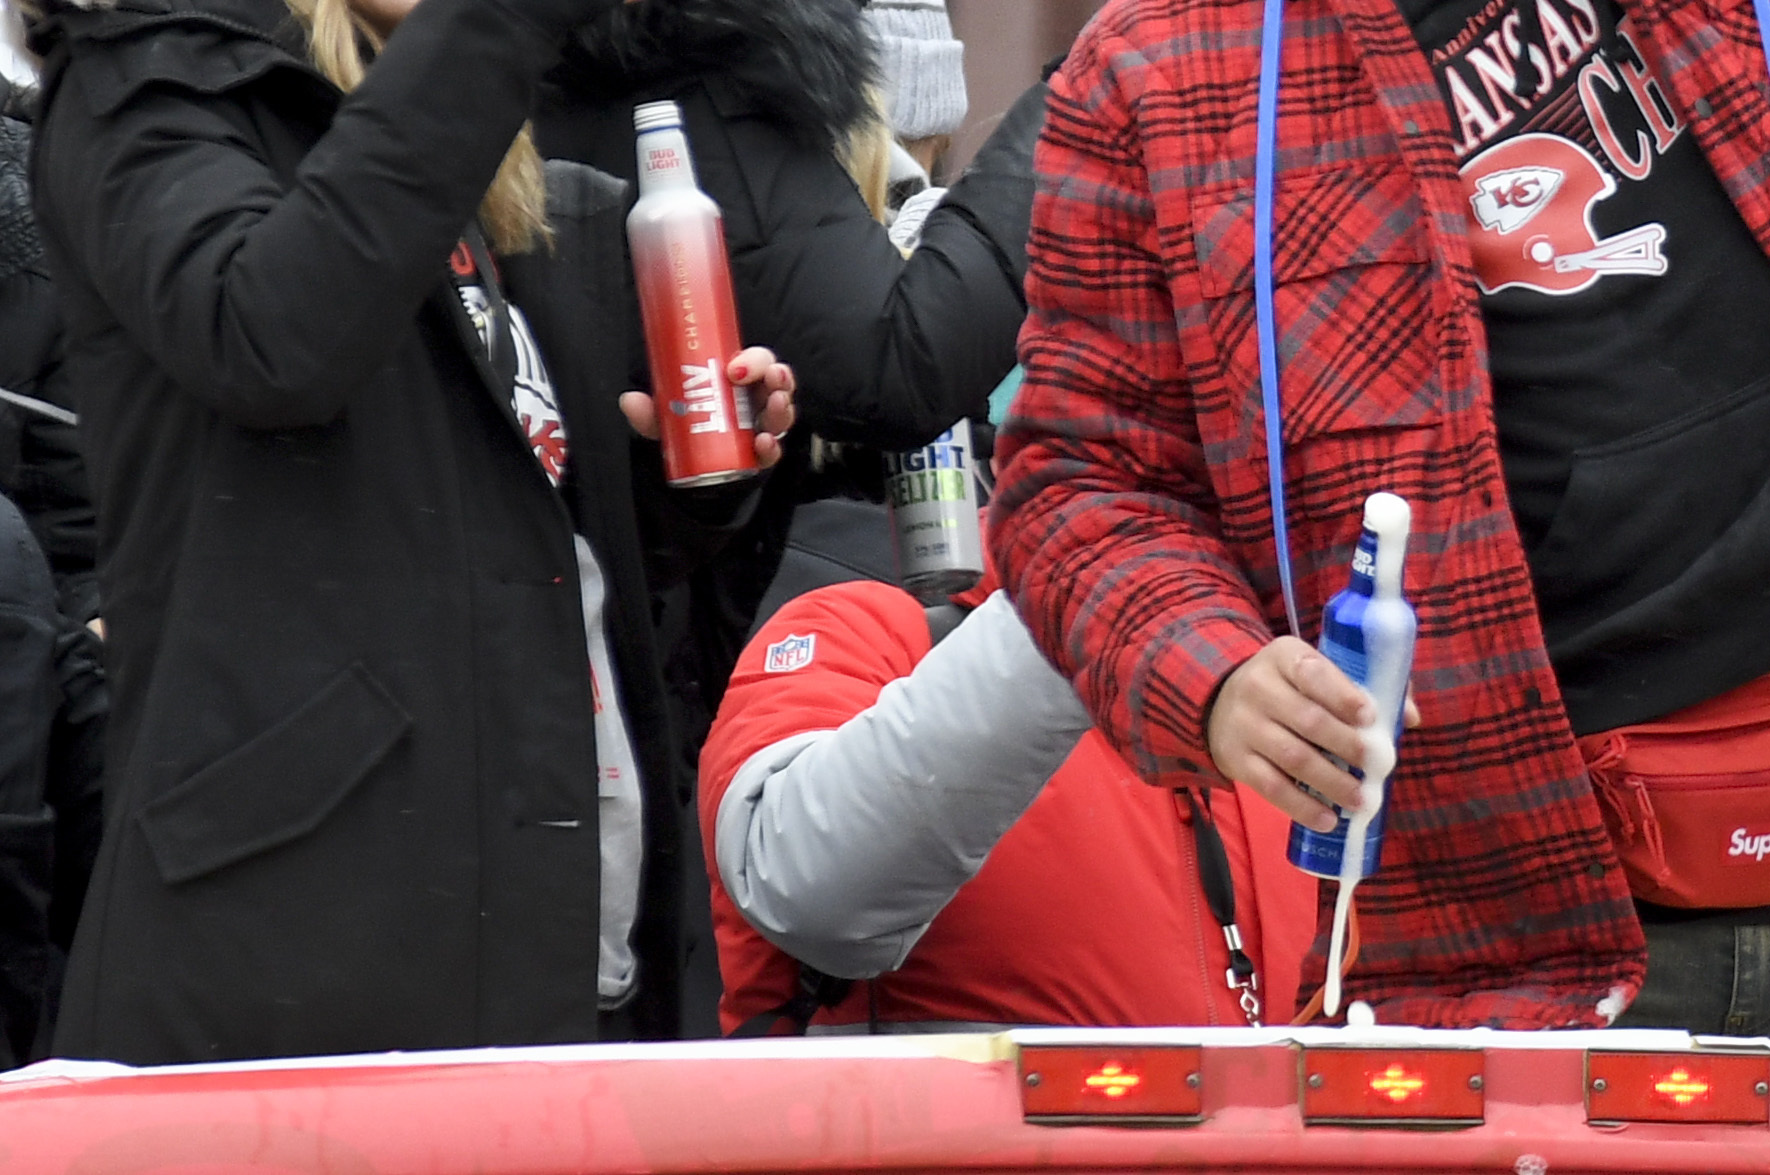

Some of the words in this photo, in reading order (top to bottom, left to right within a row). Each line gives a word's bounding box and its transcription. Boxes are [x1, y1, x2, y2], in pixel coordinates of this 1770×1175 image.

[648, 148, 676, 161] BUD
[646, 157, 681, 171] LIGHT
[1489, 176, 1544, 210] KC
[773, 650, 805, 668] NFL
